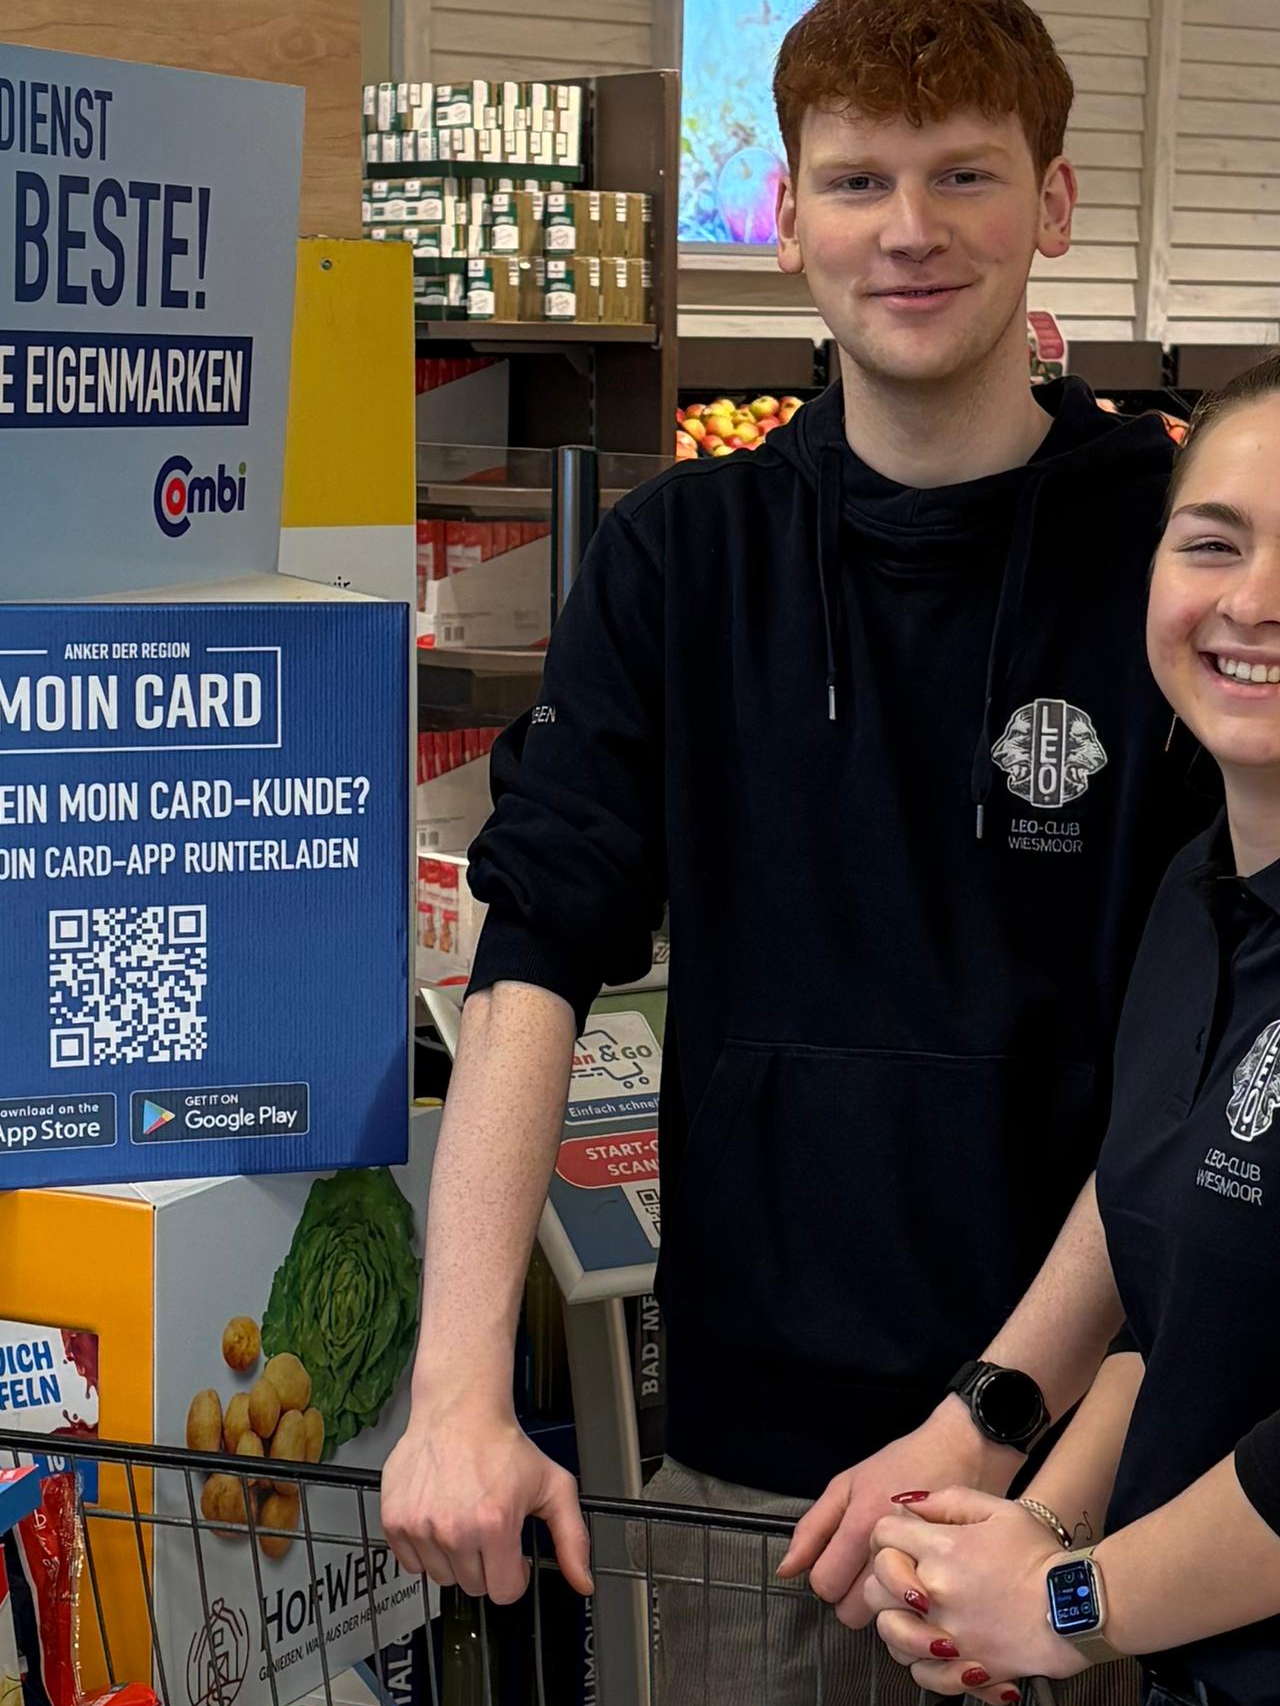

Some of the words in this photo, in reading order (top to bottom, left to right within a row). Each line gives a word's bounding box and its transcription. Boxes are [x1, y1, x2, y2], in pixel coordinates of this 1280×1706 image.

[14, 169, 211, 310] BESTE!
[26, 345, 243, 414] EIGENMARKEN
[153, 454, 247, 538] Combi
[64, 644, 108, 660] ANKER
[112, 643, 138, 659] DER
[140, 642, 190, 659] REGION
[133, 672, 263, 730] CARD
[1038, 705, 1059, 795] LEO
[60, 781, 139, 823] MOIN
[149, 777, 371, 820] CARD-KUNDE?
[1010, 819, 1081, 836] LEO-CLUB
[44, 842, 175, 878] CARD-APP
[184, 838, 359, 873] RUNTERLADEN
[1008, 836, 1084, 854] WIESMOOR
[621, 1044, 652, 1060] GO
[58, 1105, 76, 1115] on
[79, 1102, 99, 1114] the
[185, 1096, 207, 1106] GET
[209, 1095, 218, 1105] IT
[221, 1094, 238, 1104] ON
[570, 1102, 616, 1117] Einfach
[41, 1118, 100, 1141] Store
[185, 1108, 255, 1133] Google
[259, 1105, 297, 1129] Play
[1204, 1147, 1261, 1181] LEO-CLUB
[1196, 1168, 1263, 1206] WIESMOOR
[641, 1343, 659, 1396] BAD
[342, 1617, 360, 1639] DER
